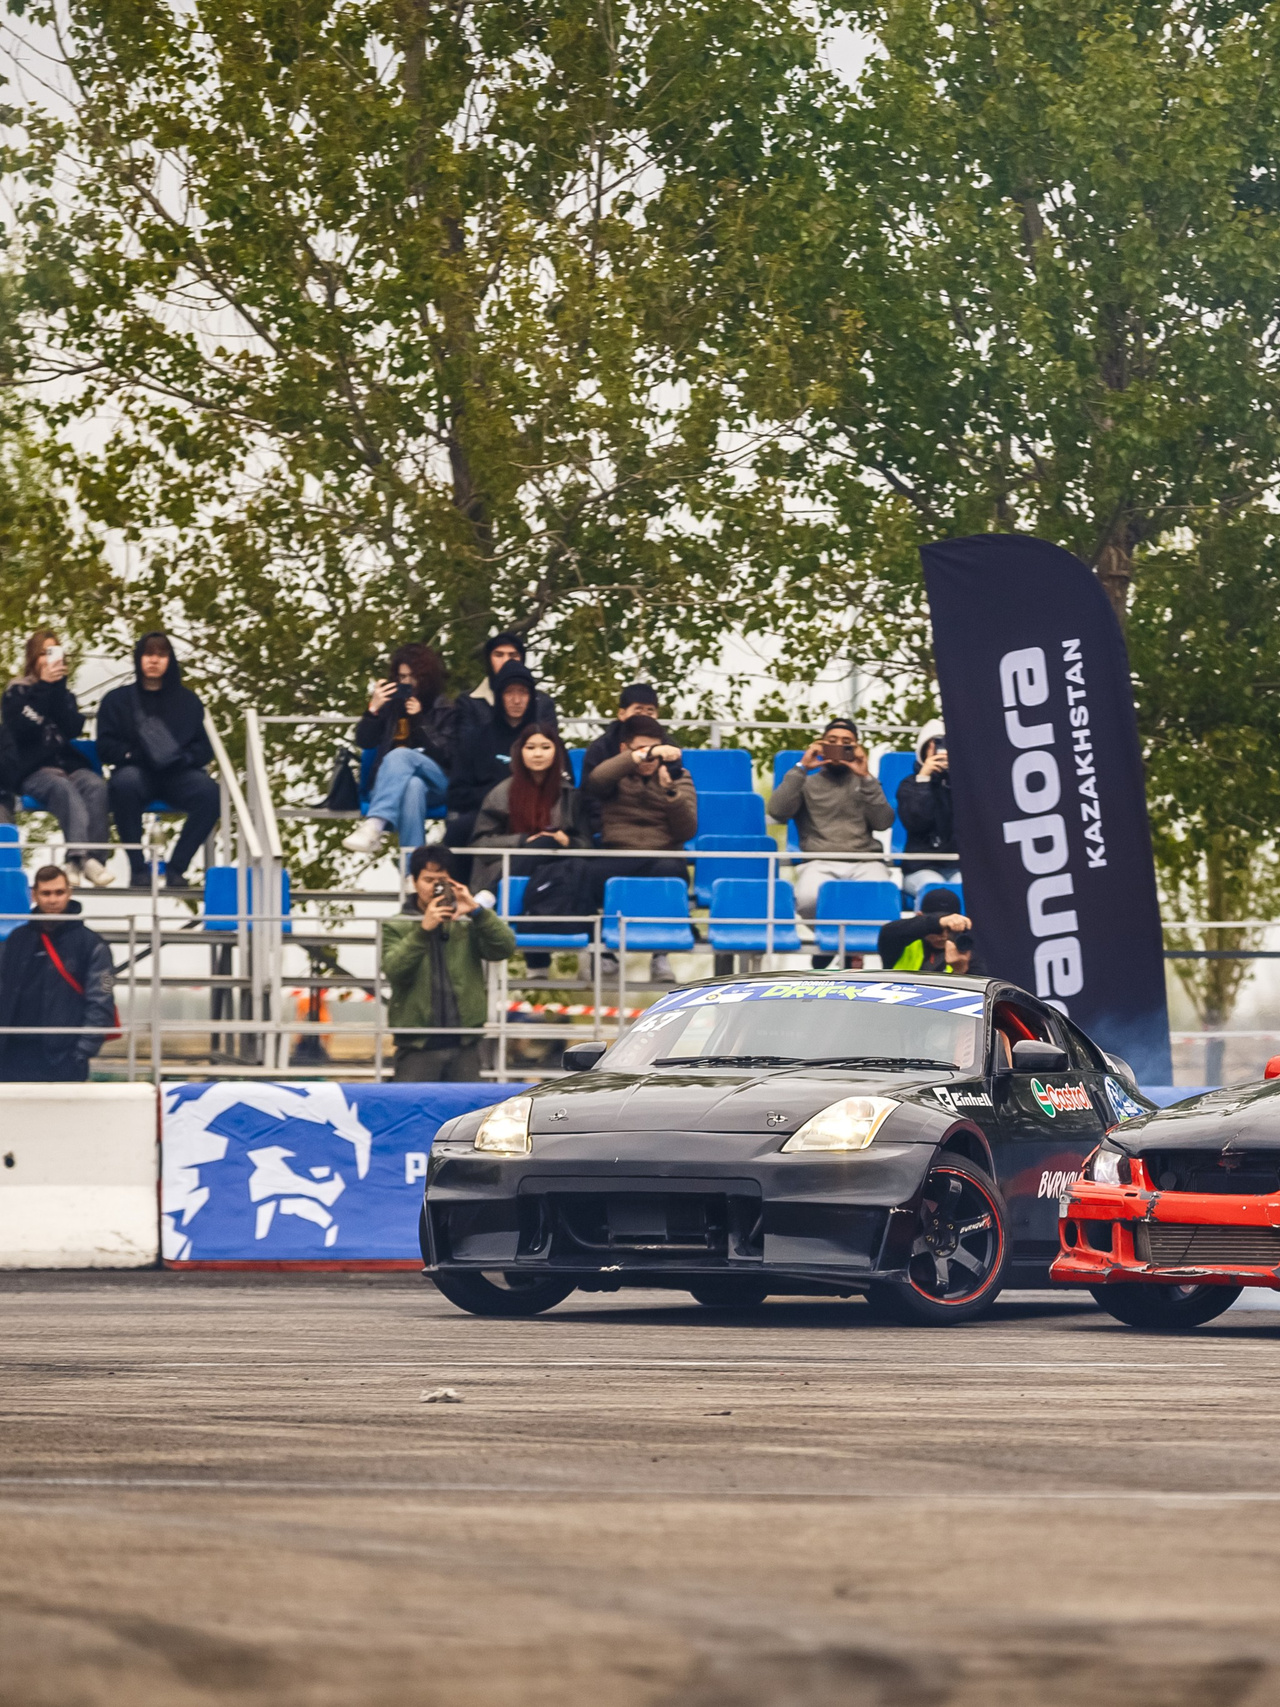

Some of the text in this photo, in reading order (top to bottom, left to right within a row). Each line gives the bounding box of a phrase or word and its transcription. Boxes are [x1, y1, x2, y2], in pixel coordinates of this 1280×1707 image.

[1062, 638, 1107, 868] KAZAKHSTAN
[999, 646, 1084, 1019] andora
[950, 1092, 993, 1107] Einhell
[1046, 1081, 1093, 1112] Castrol
